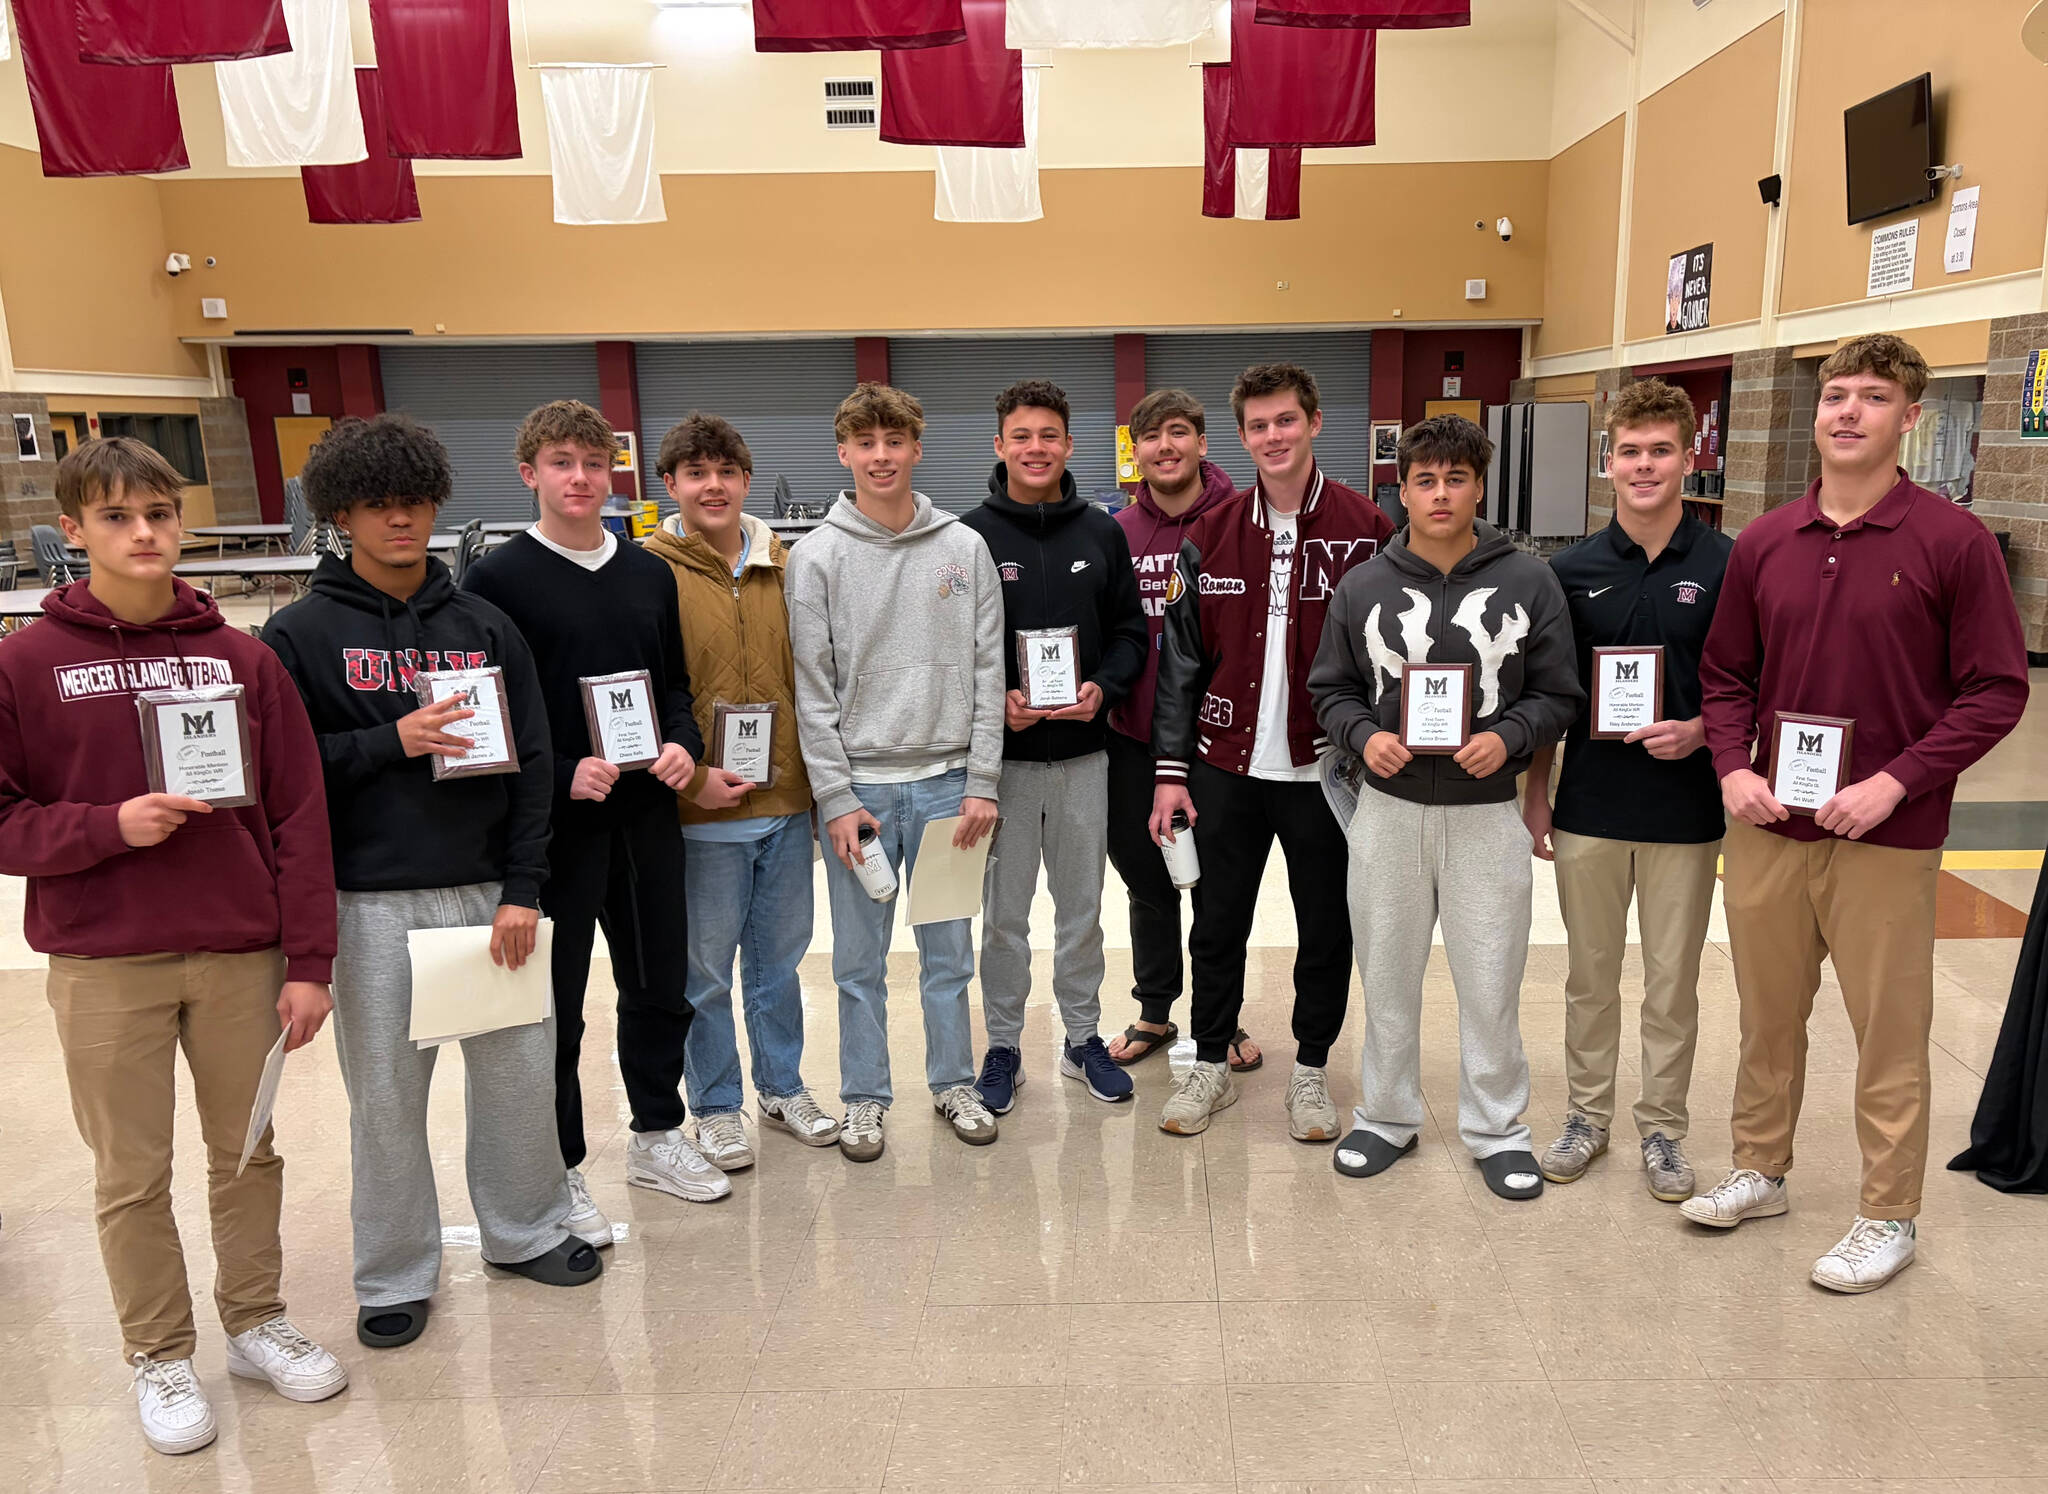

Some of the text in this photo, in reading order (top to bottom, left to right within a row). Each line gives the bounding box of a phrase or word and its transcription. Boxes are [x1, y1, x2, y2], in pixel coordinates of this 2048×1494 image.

[1874, 225, 1916, 245] COMMONS RULES
[1685, 276, 1707, 298] NEVER
[935, 563, 970, 584] GONZAGA
[1199, 574, 1244, 593] Roman
[60, 661, 232, 697] MERCER ISLAND FOOTBALL
[201, 749, 226, 758] Football
[1806, 766, 1826, 774] Football
